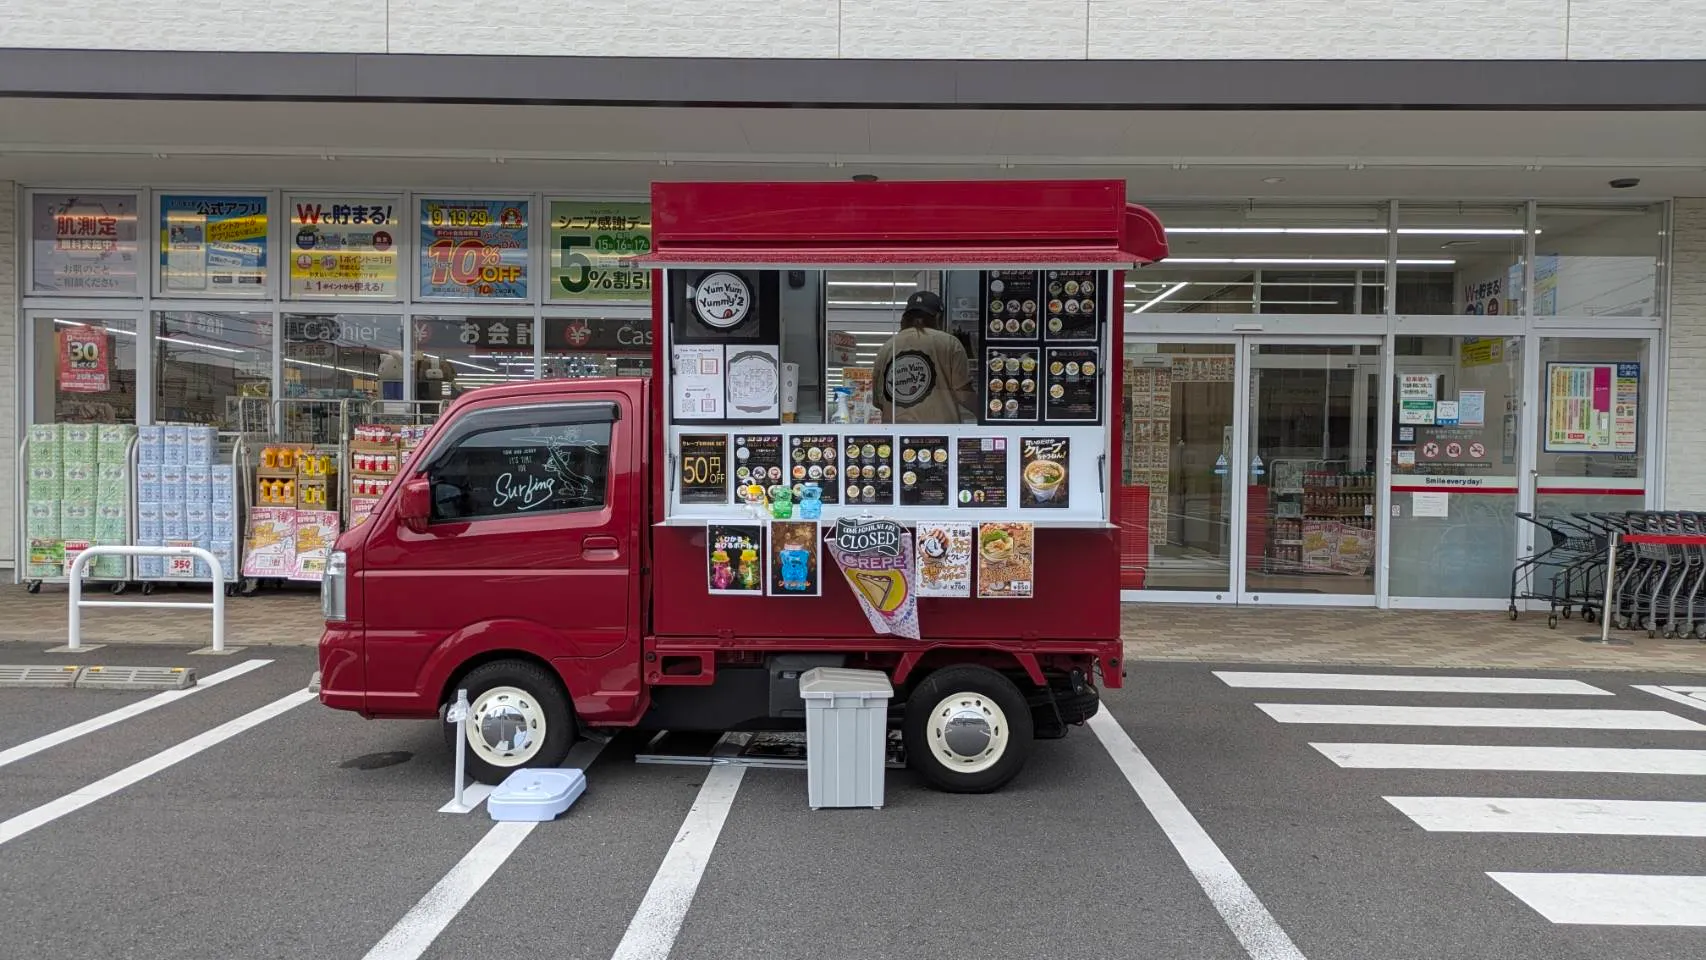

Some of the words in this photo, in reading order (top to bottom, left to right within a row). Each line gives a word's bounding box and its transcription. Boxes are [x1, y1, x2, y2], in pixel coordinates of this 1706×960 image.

[56, 216, 117, 236] 肌測定
[482, 267, 521, 283] OFF
[703, 285, 723, 295] Yum
[724, 283, 743, 294] Yum
[460, 322, 534, 345] お会計
[70, 341, 99, 361] 30
[709, 473, 726, 484] OFF
[1425, 477, 1446, 485] Smile
[493, 472, 556, 510] Surfing
[840, 530, 896, 549] CLOSED
[838, 550, 908, 570] CREPE
